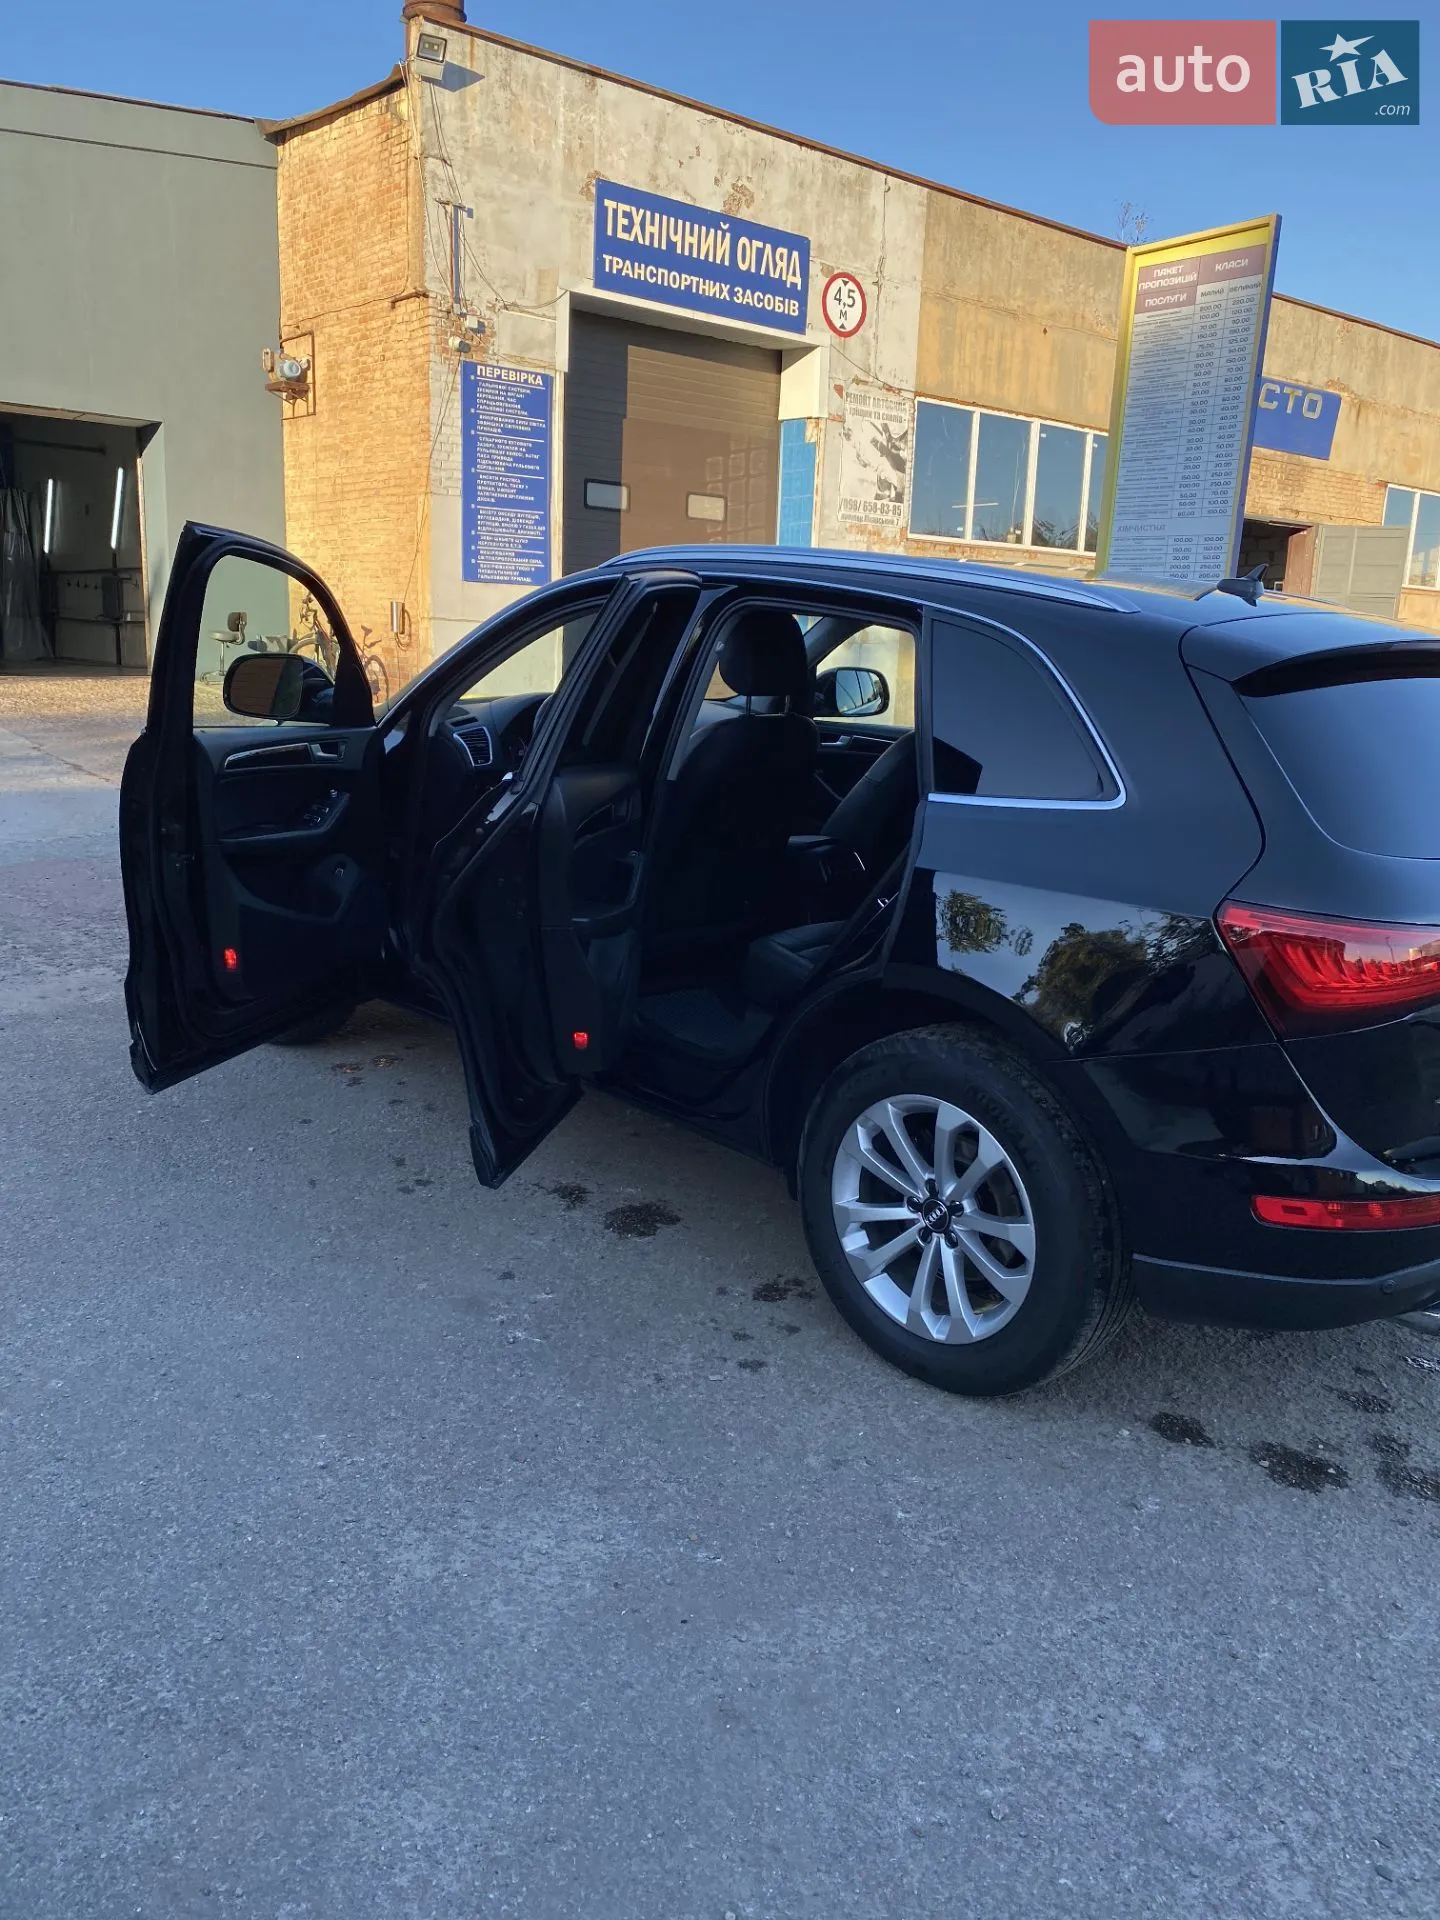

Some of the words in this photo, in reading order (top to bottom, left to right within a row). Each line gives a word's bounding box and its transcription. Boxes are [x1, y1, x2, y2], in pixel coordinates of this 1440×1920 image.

[604, 198, 731, 267] ТЕХНІЧНИЙ
[737, 236, 802, 290] ОГЛЯД
[1154, 265, 1184, 278] ПАКЕТ
[1215, 258, 1249, 273] КЛАСИ
[602, 253, 731, 301] ТРАНСПОРТНИХ
[733, 287, 799, 317] ЗАСОБІВ
[833, 286, 856, 310] 4,5
[1145, 293, 1188, 308] ПОСЛУГИ
[476, 365, 543, 386] ПЕРЕВІРКА
[1259, 383, 1322, 419] СТО
